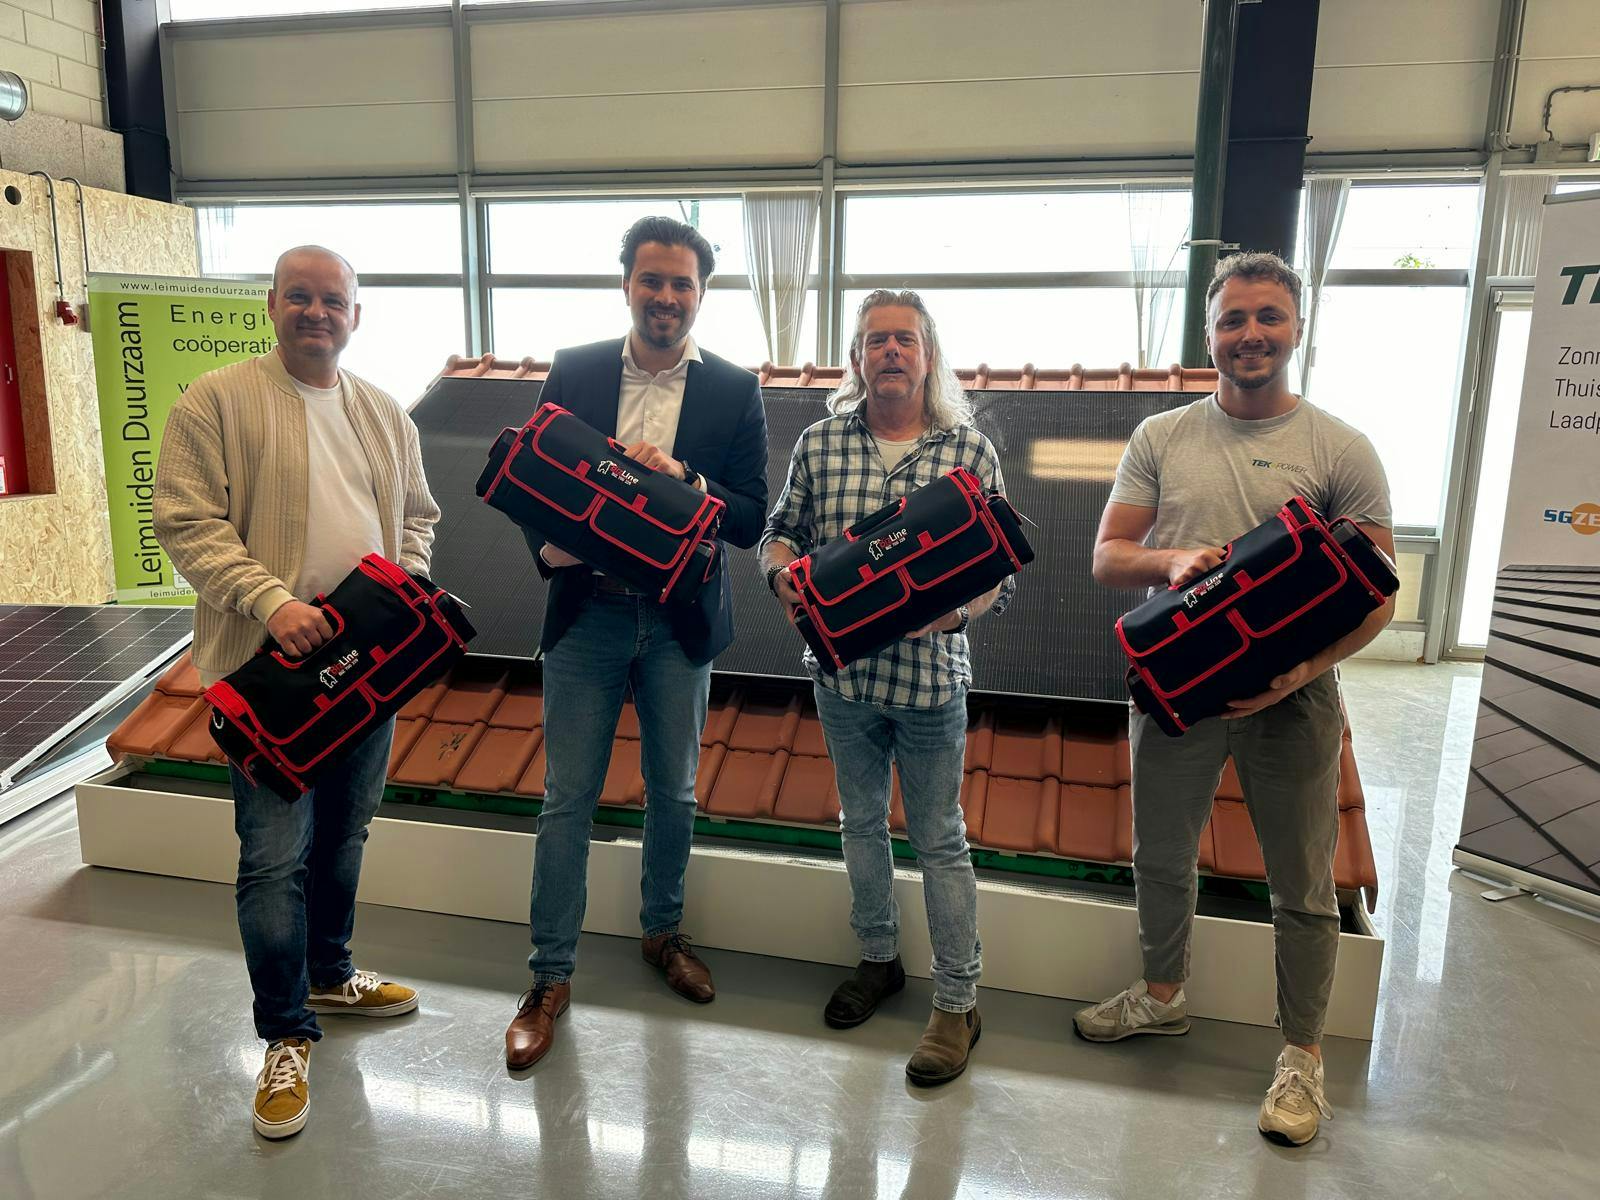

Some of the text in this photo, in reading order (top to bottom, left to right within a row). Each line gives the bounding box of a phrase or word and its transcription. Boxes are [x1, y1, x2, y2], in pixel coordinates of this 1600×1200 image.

[120, 281, 267, 296] www.leimuidenduurzaam
[172, 335, 273, 357] coöperati
[117, 301, 163, 587] Leimuiden Duurzaam
[1252, 459, 1272, 468] TEK
